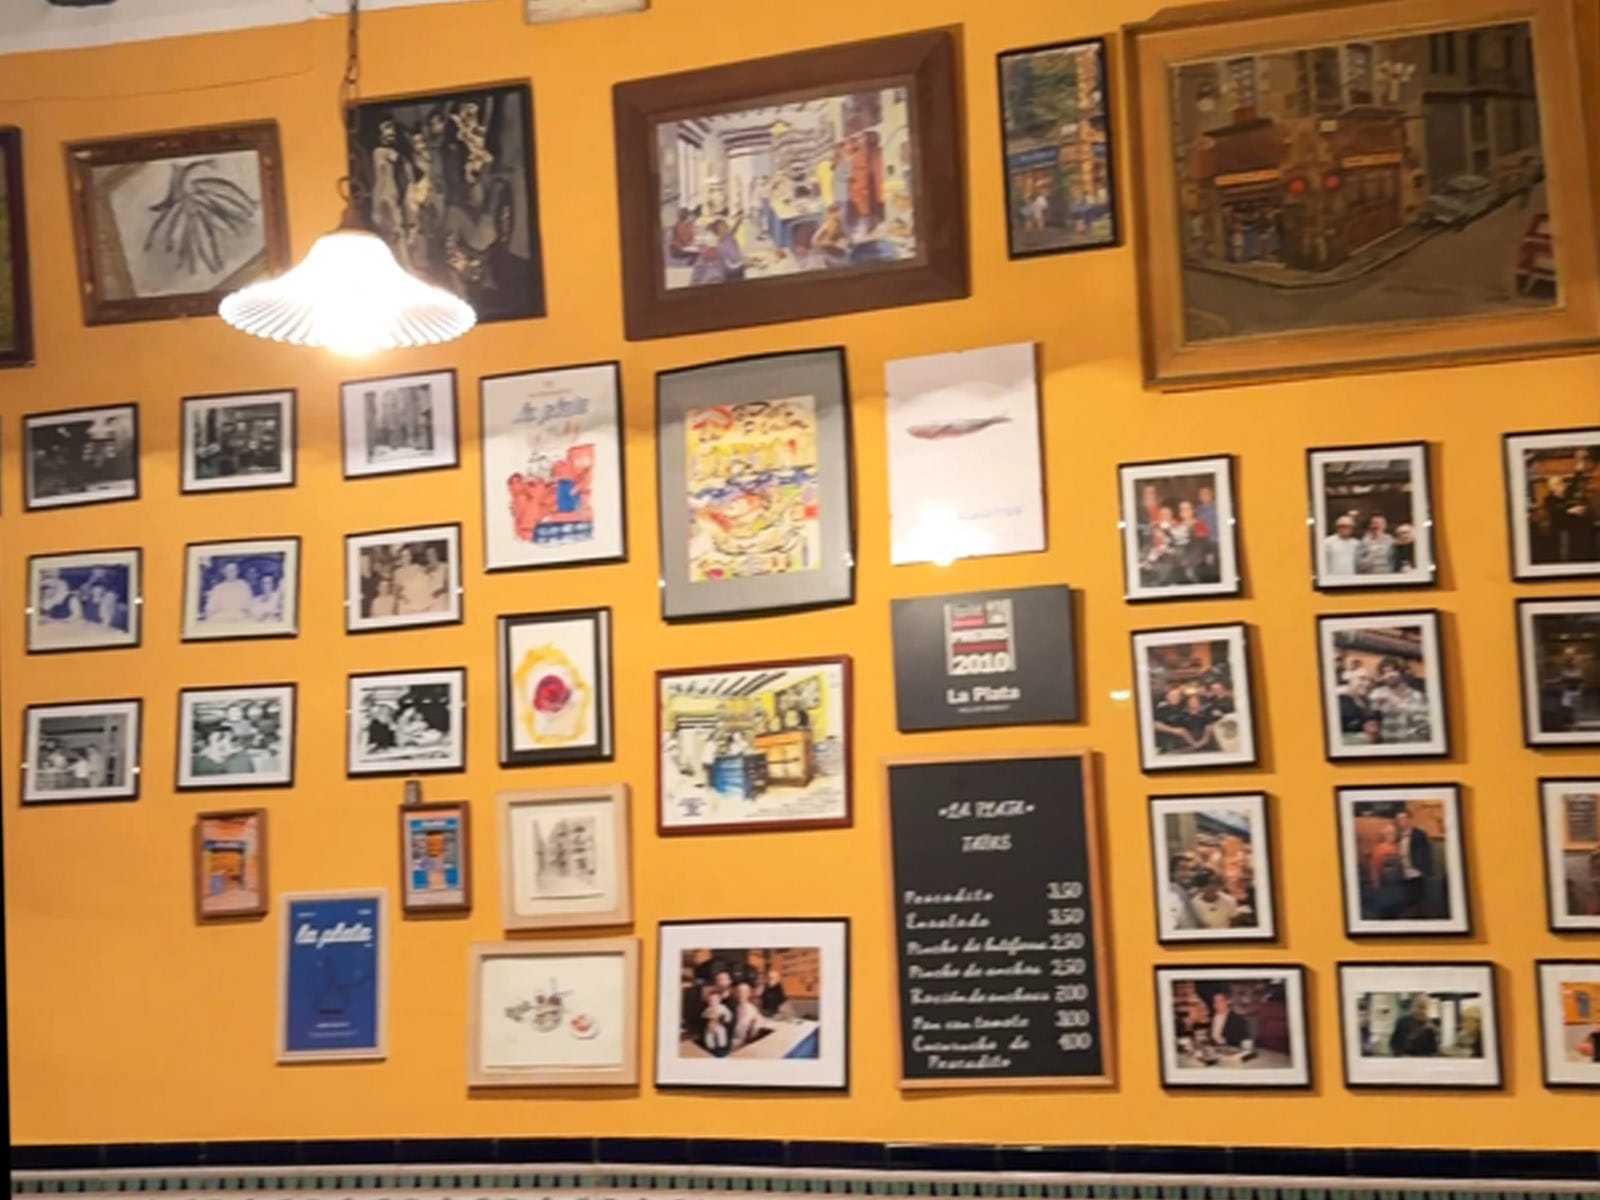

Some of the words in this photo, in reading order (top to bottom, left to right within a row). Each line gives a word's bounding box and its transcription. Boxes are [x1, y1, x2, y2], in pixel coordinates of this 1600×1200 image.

[951, 651, 1010, 675] 2010
[946, 688, 970, 704] La
[972, 685, 1022, 702] Plata
